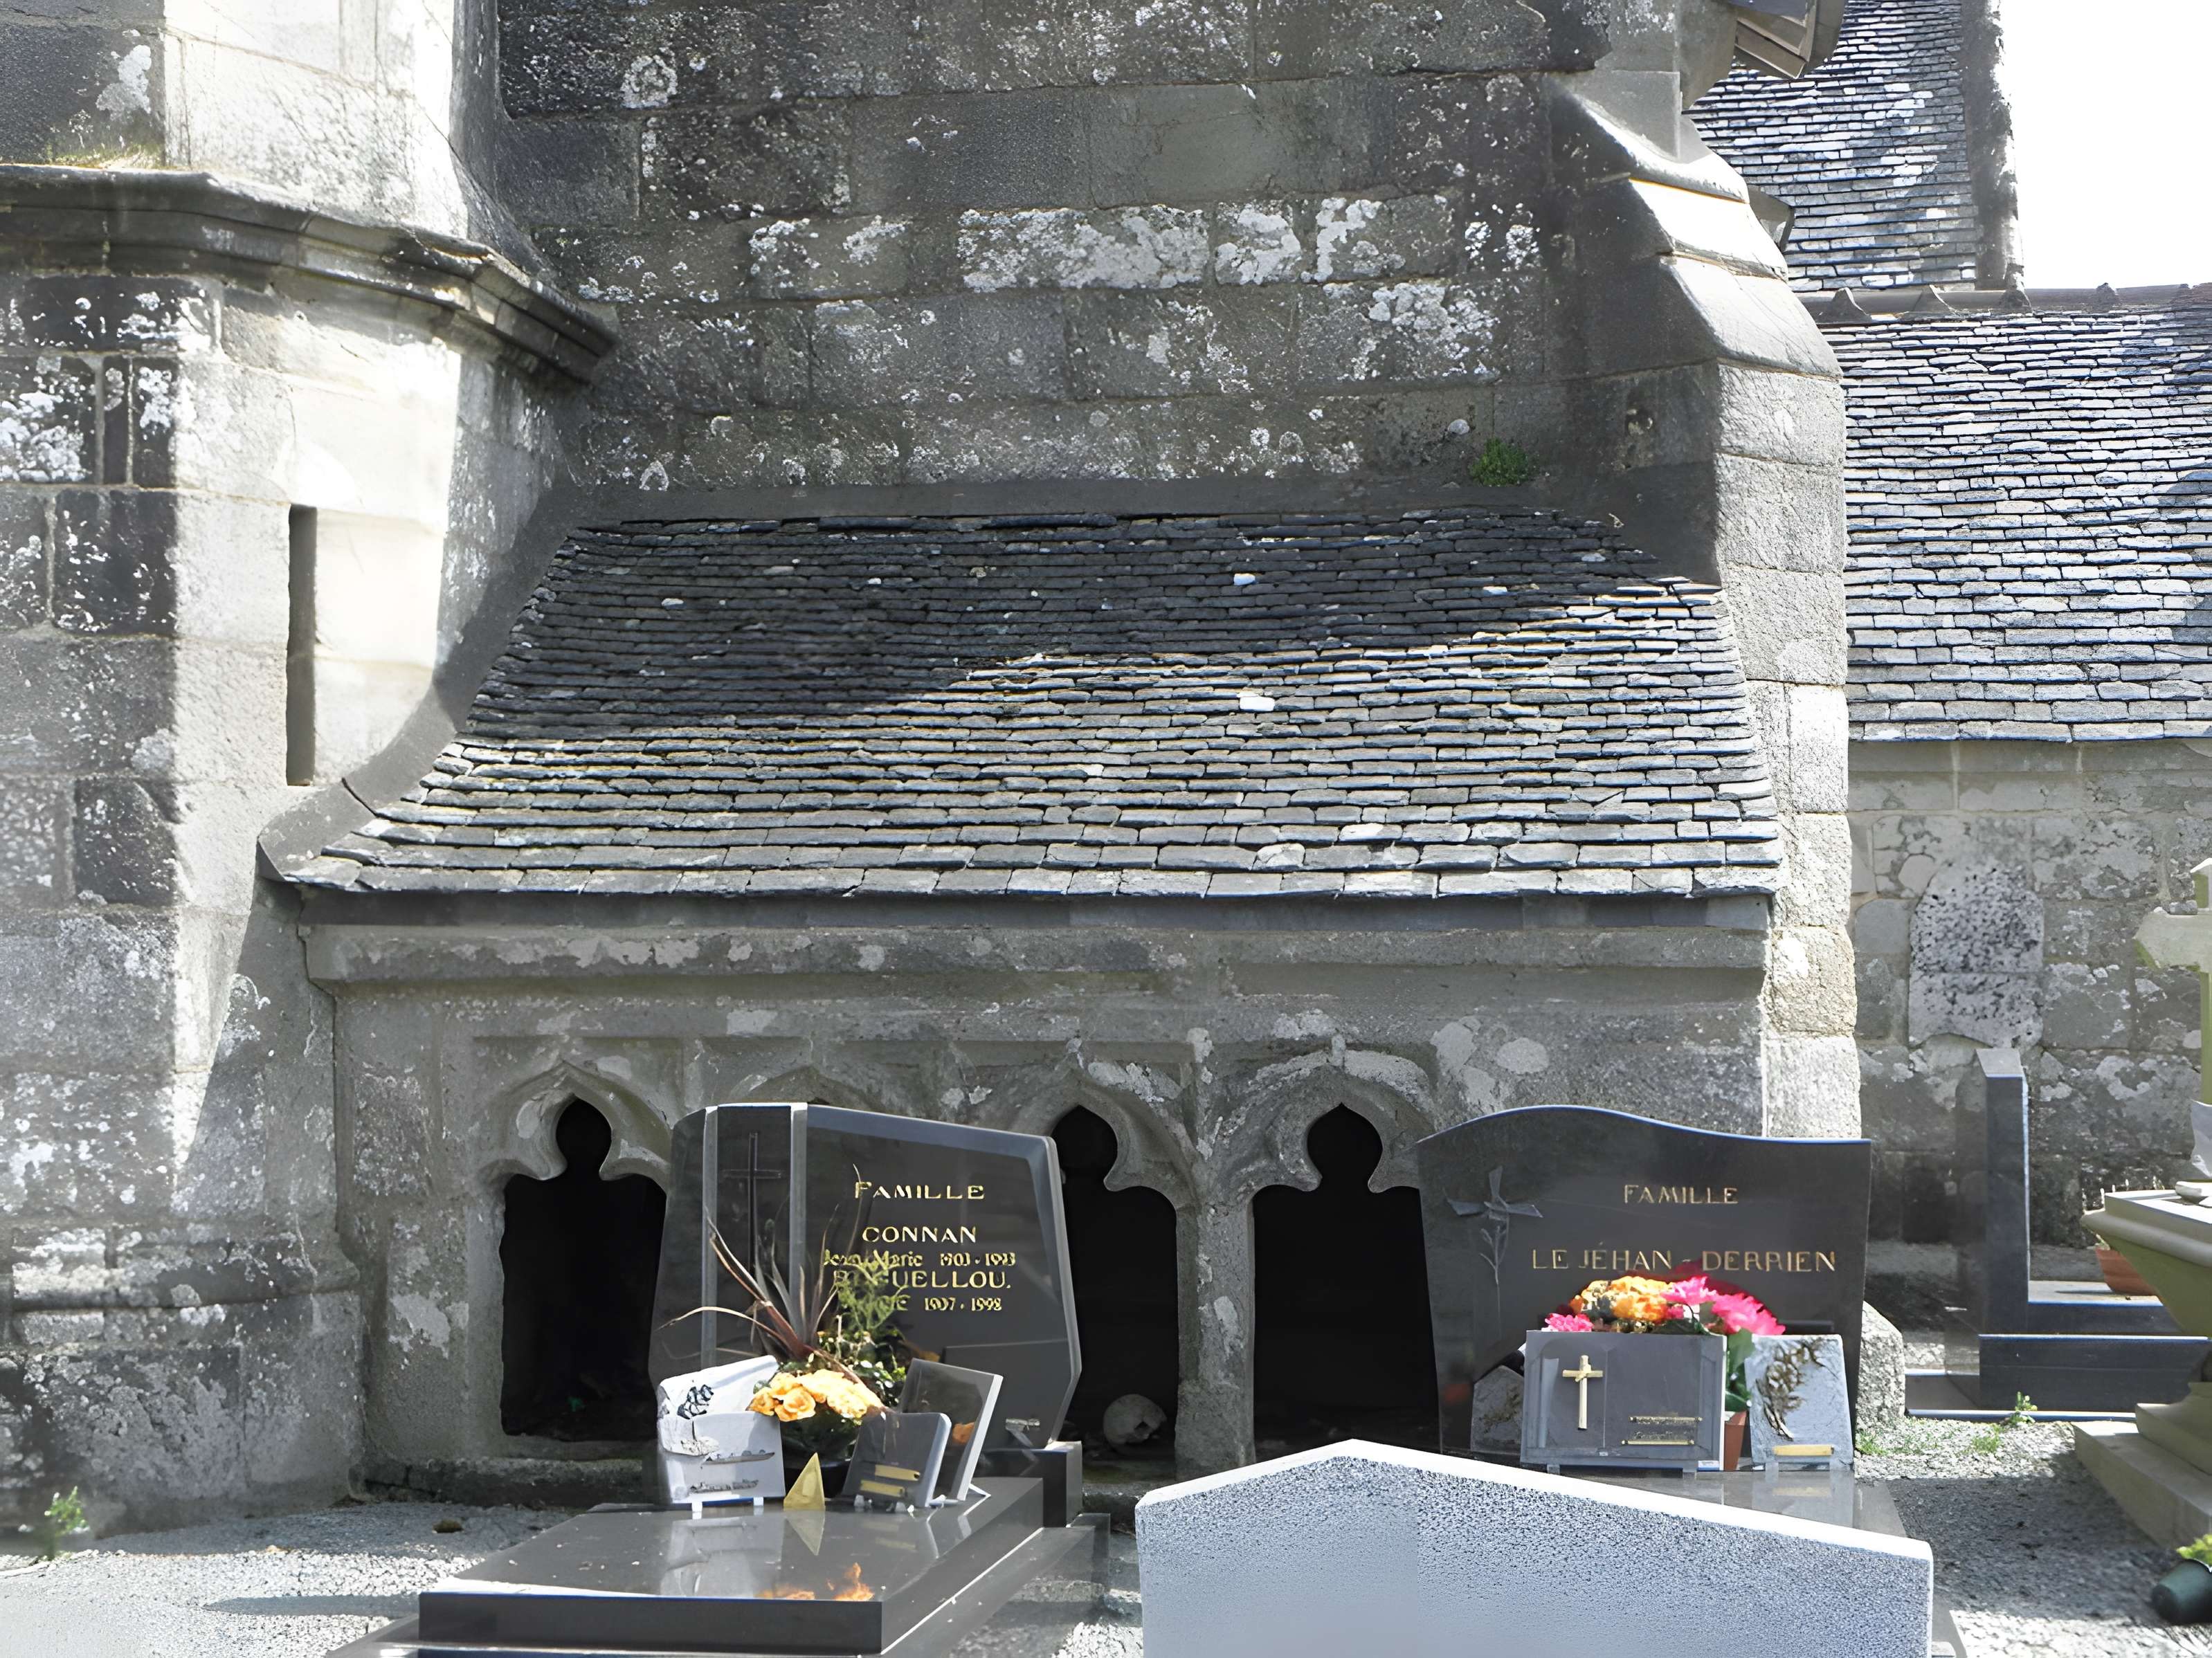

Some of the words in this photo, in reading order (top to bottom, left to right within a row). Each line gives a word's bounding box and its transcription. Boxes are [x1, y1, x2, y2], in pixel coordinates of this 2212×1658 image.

[853, 1181, 986, 1200] FAMILLE
[1624, 1184, 1739, 1204] FAMILLE
[862, 1226, 977, 1244] CONNAN
[1532, 1249, 1569, 1270] LE
[1702, 1250, 1835, 1272] DERRIEN
